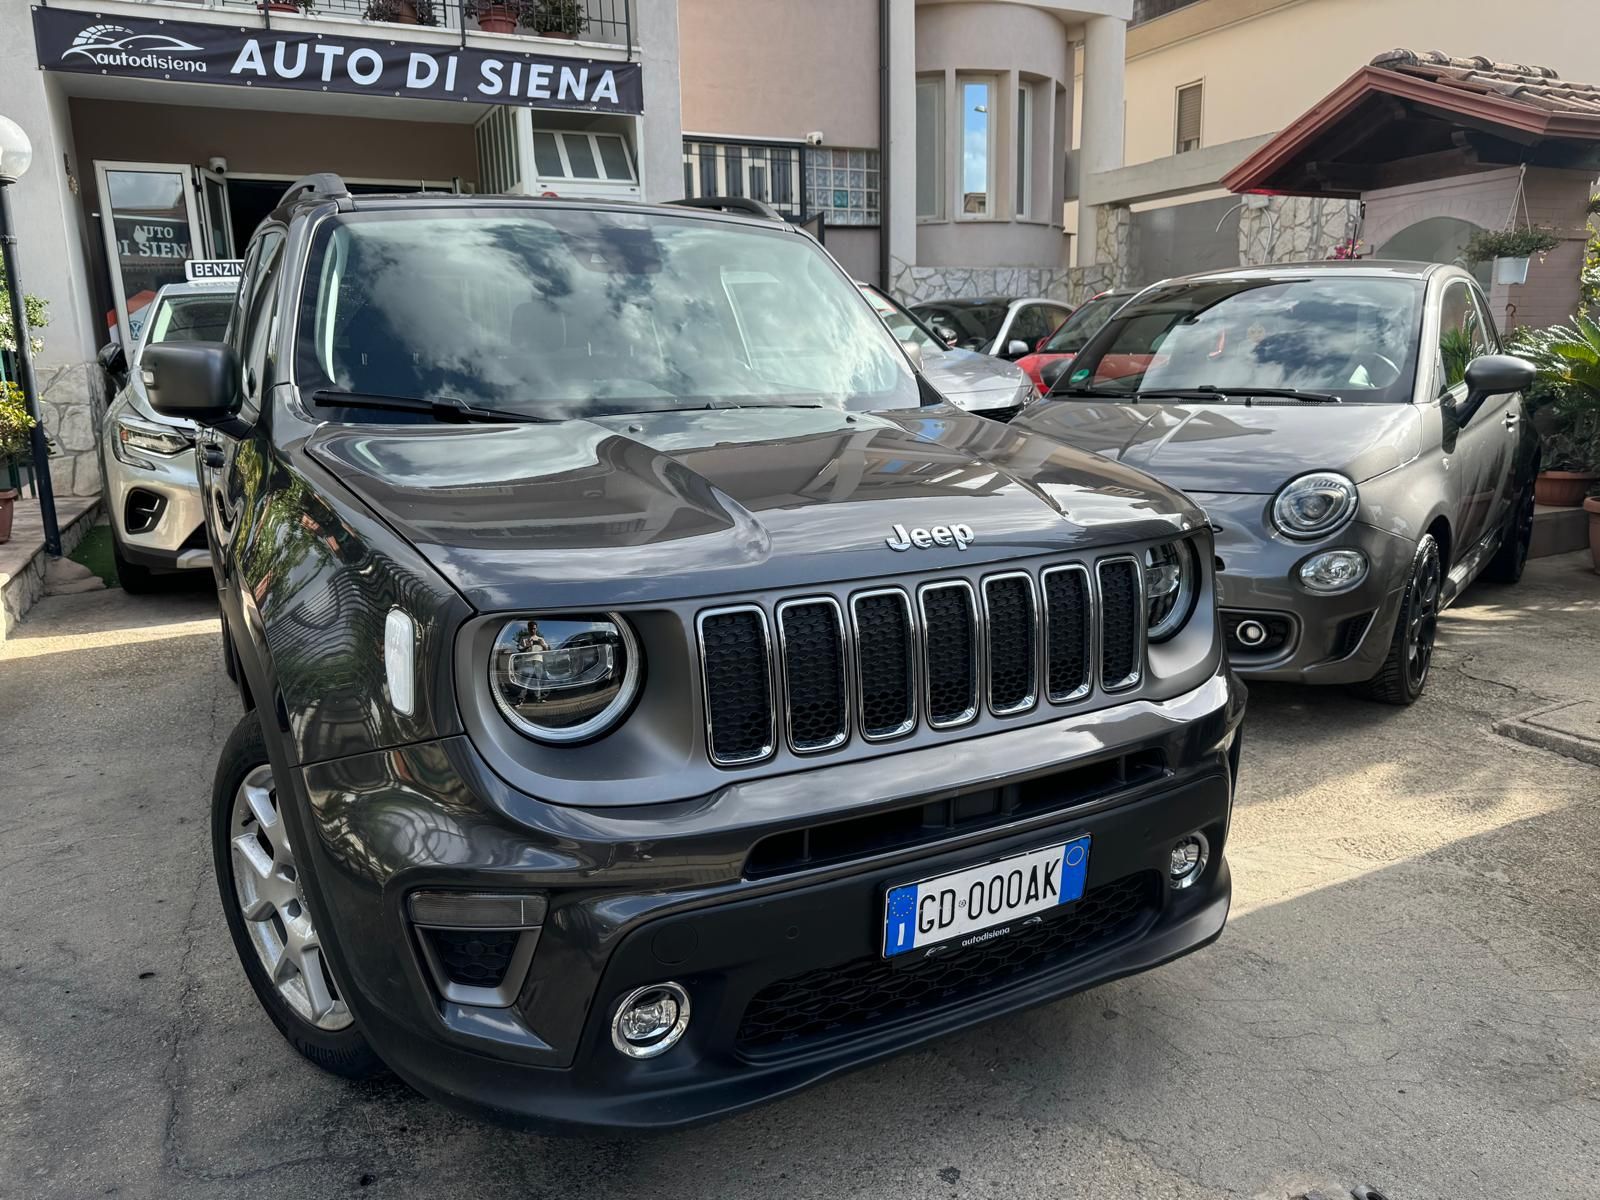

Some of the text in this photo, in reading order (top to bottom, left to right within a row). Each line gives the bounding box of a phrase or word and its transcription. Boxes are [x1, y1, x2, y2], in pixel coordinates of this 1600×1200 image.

[96, 51, 207, 73] autodisiena
[231, 39, 619, 103] AUTO DI SIENA
[885, 523, 975, 551] Jeep
[961, 927, 1010, 947] autodisiena
